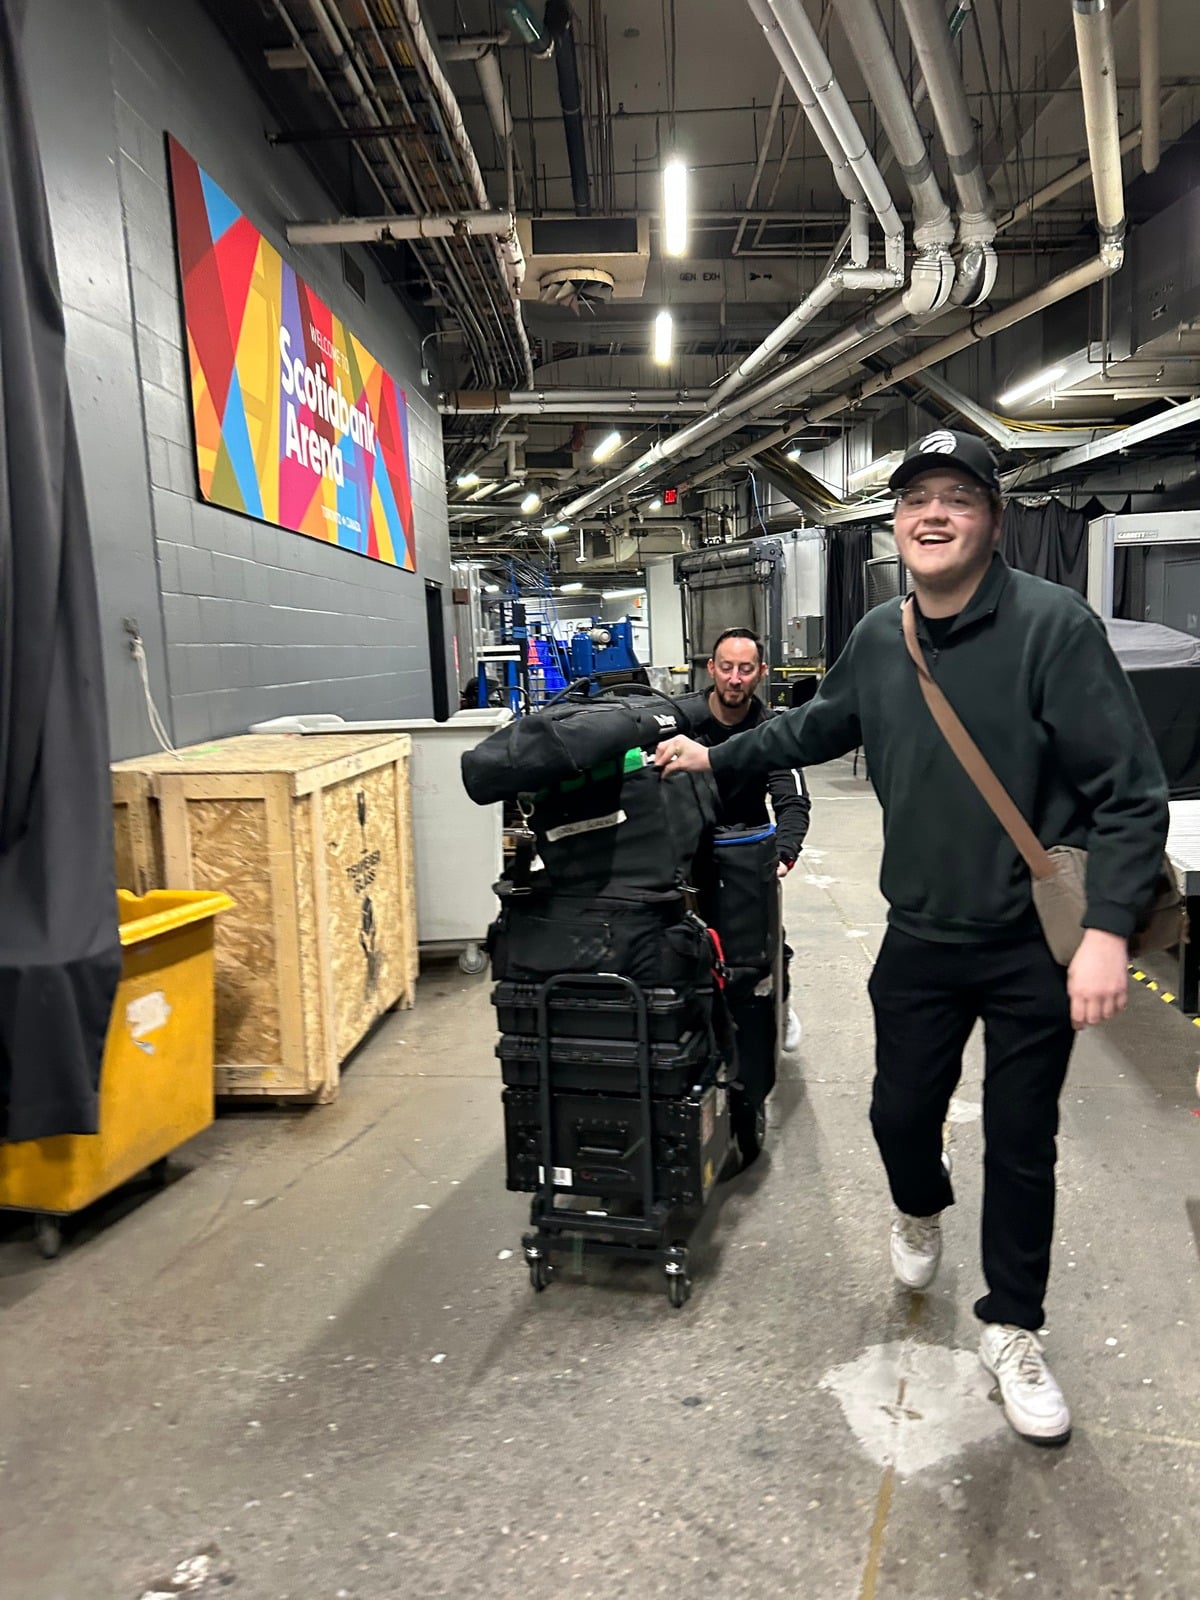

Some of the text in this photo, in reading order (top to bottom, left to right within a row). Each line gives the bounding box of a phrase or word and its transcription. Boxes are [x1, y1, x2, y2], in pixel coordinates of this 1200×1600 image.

[679, 272, 720, 281] GEN EXH
[309, 322, 350, 375] WELCOME TO
[279, 325, 377, 457] Scotiabank
[285, 401, 345, 488] Arena
